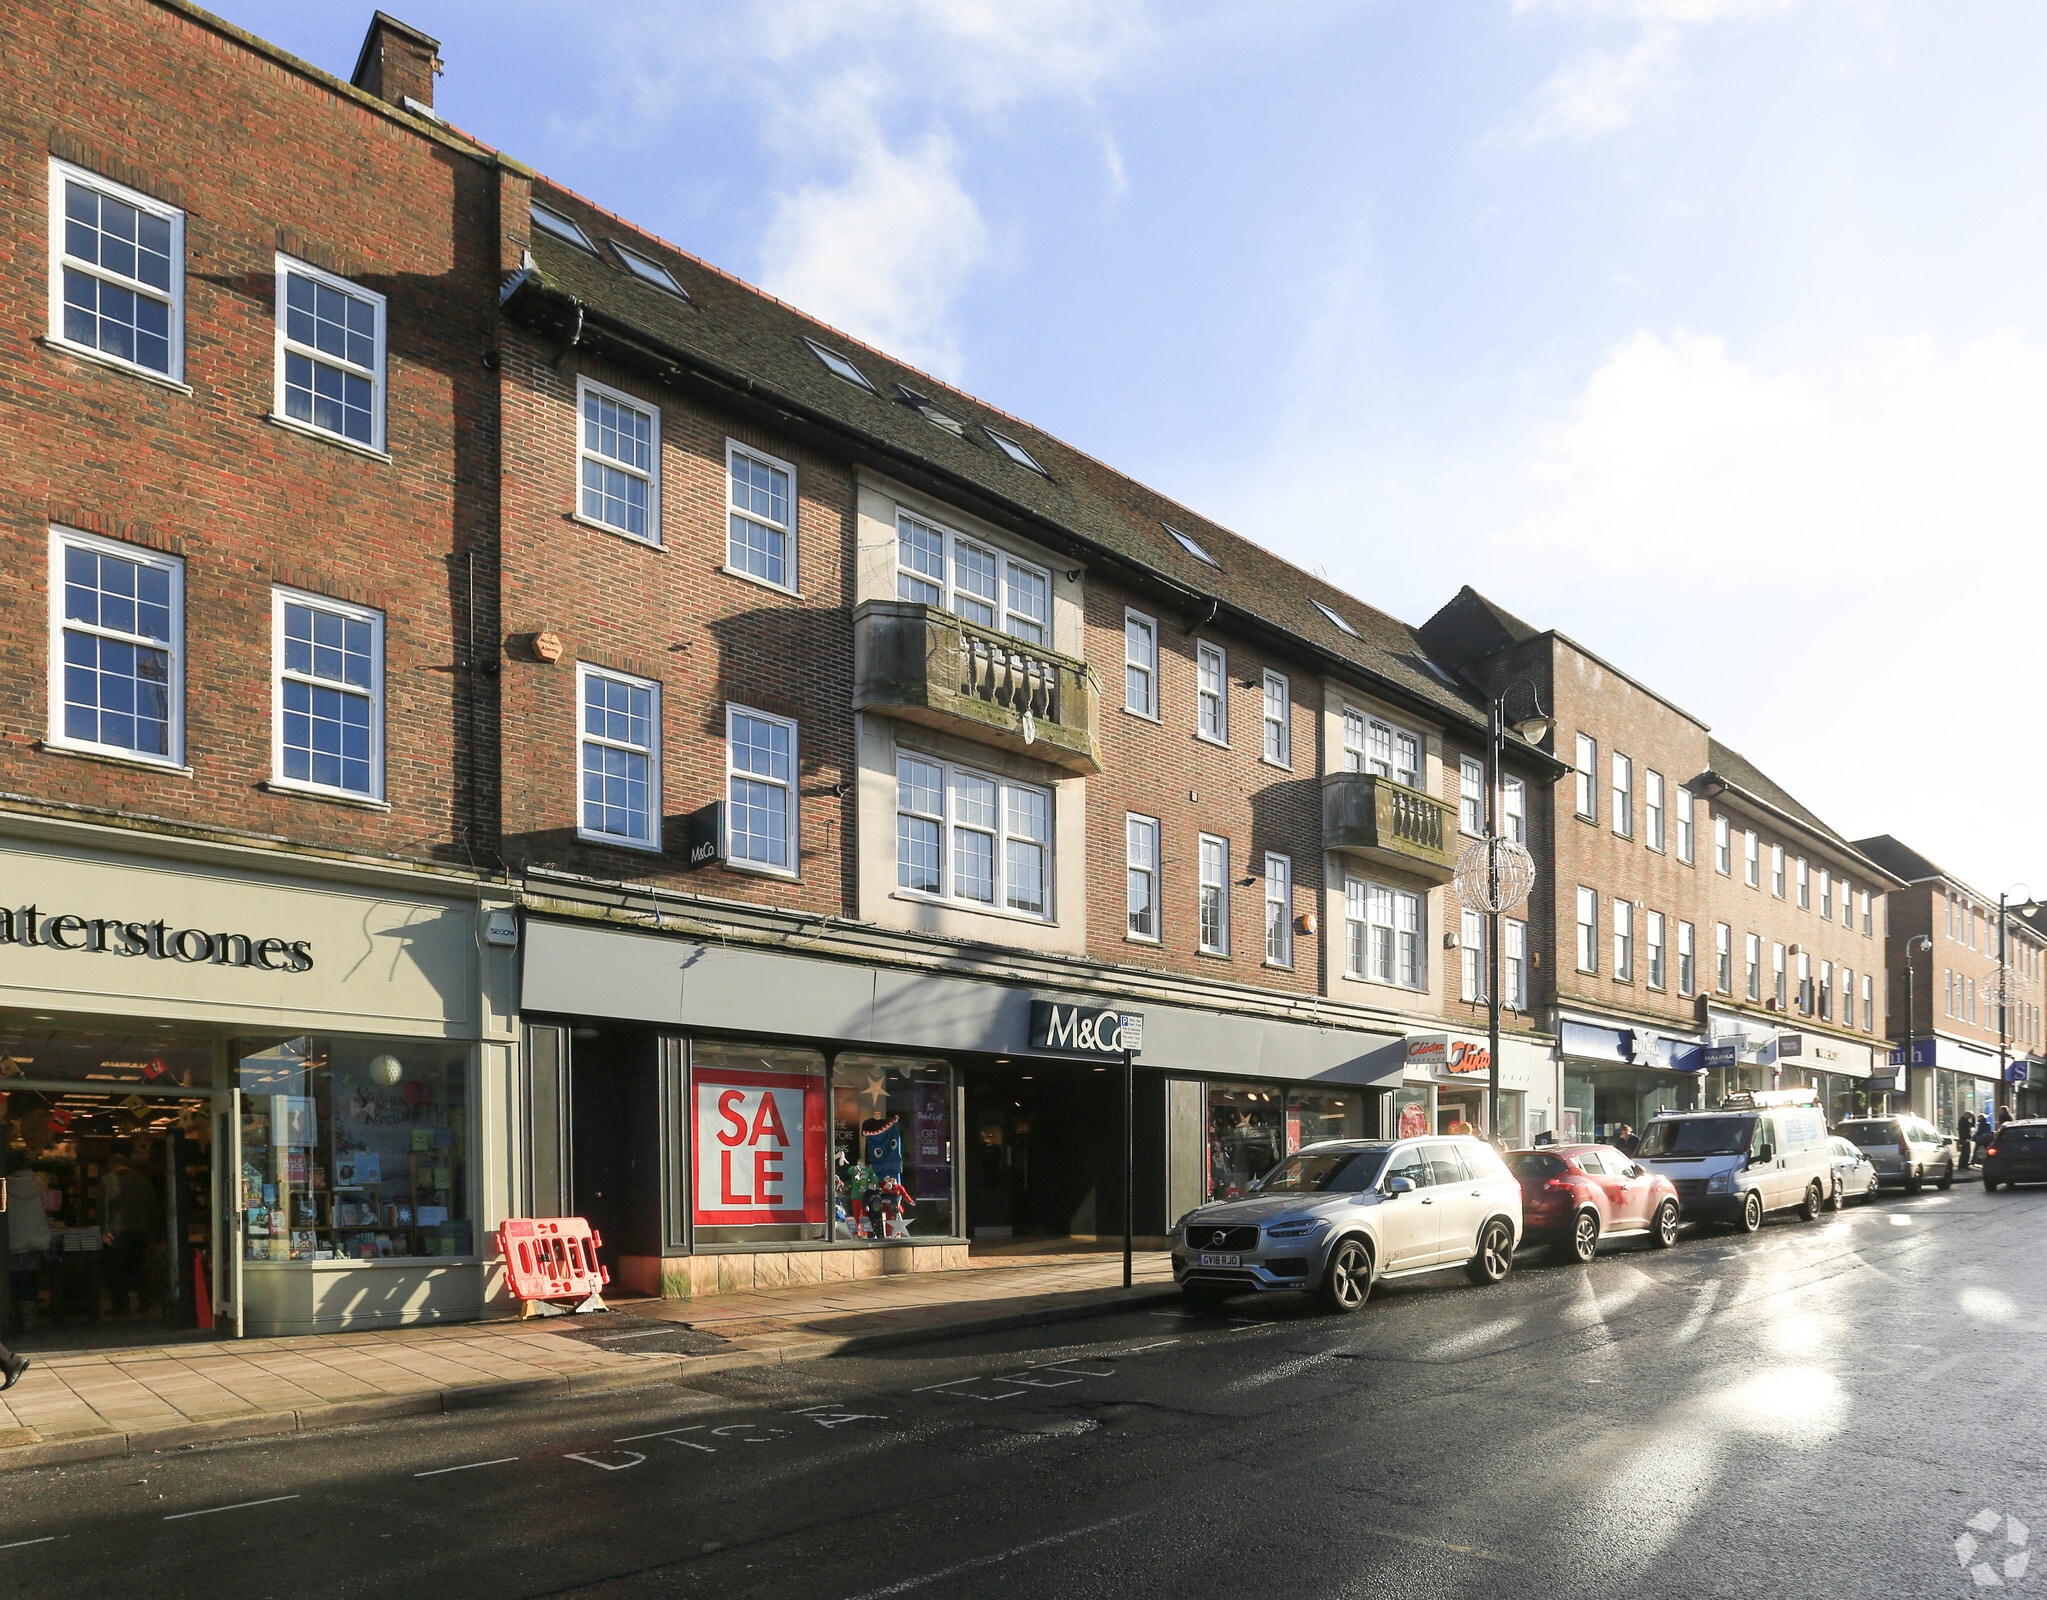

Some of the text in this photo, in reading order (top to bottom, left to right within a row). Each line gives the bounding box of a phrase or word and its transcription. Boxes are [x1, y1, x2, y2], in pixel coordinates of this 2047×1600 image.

[490, 928, 515, 937] SECOM
[1632, 1039, 1660, 1057] HALIFAX
[1705, 1053, 1734, 1061] HALIFAX
[921, 1128, 938, 1140] GIFT
